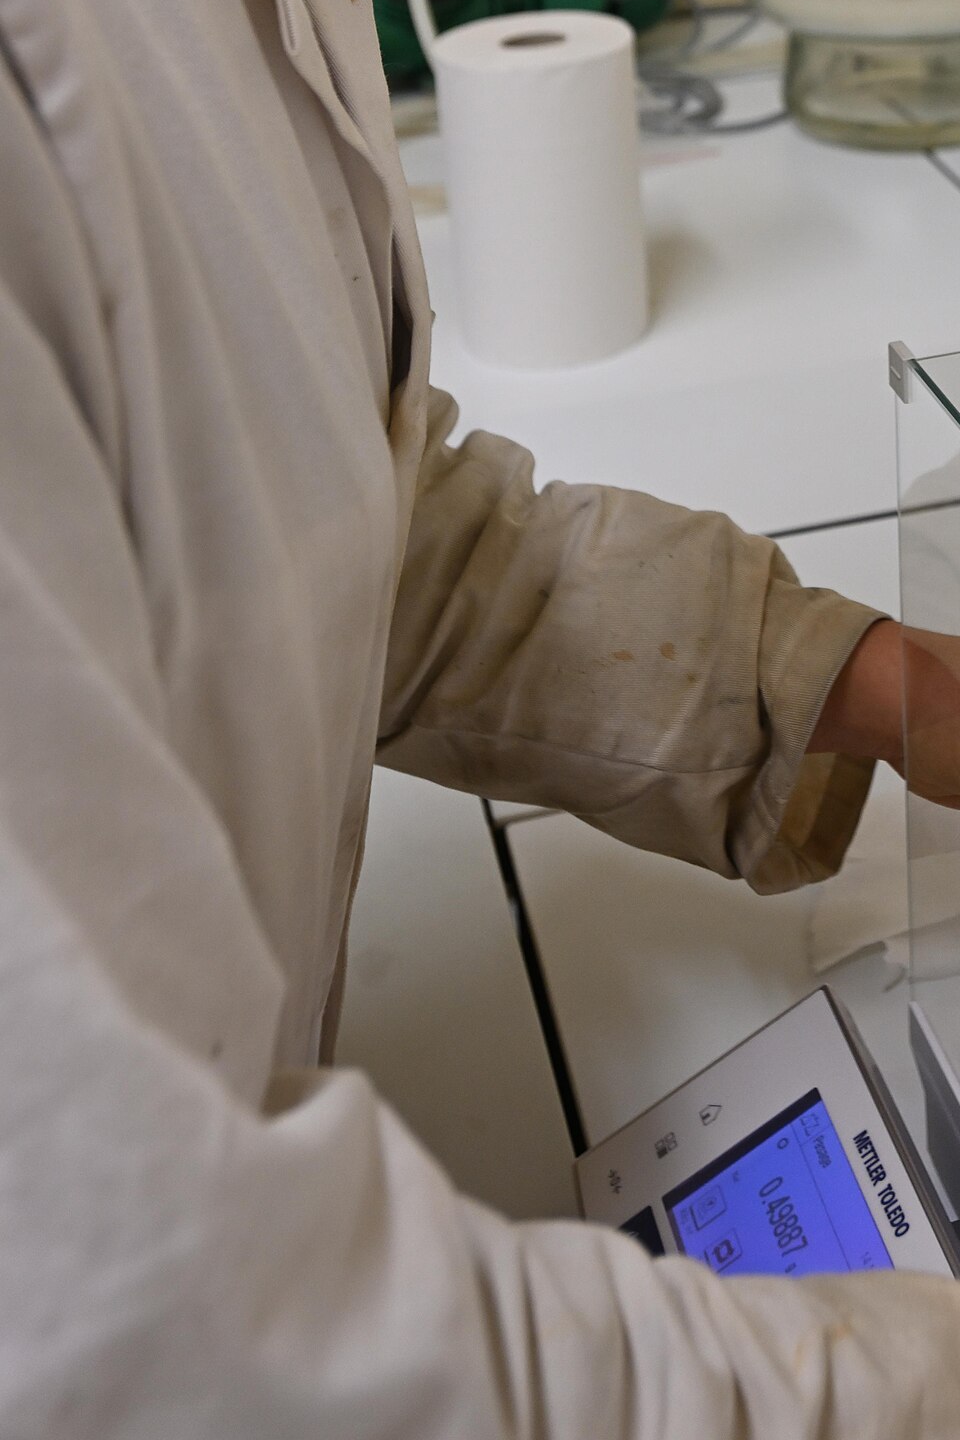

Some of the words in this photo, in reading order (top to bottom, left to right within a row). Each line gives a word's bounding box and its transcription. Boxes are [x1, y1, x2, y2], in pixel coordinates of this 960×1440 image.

[759, 1176, 808, 1258] 0.49887
[853, 1129, 887, 1187] METTLER
[877, 1183, 910, 1238] TOLEDO
